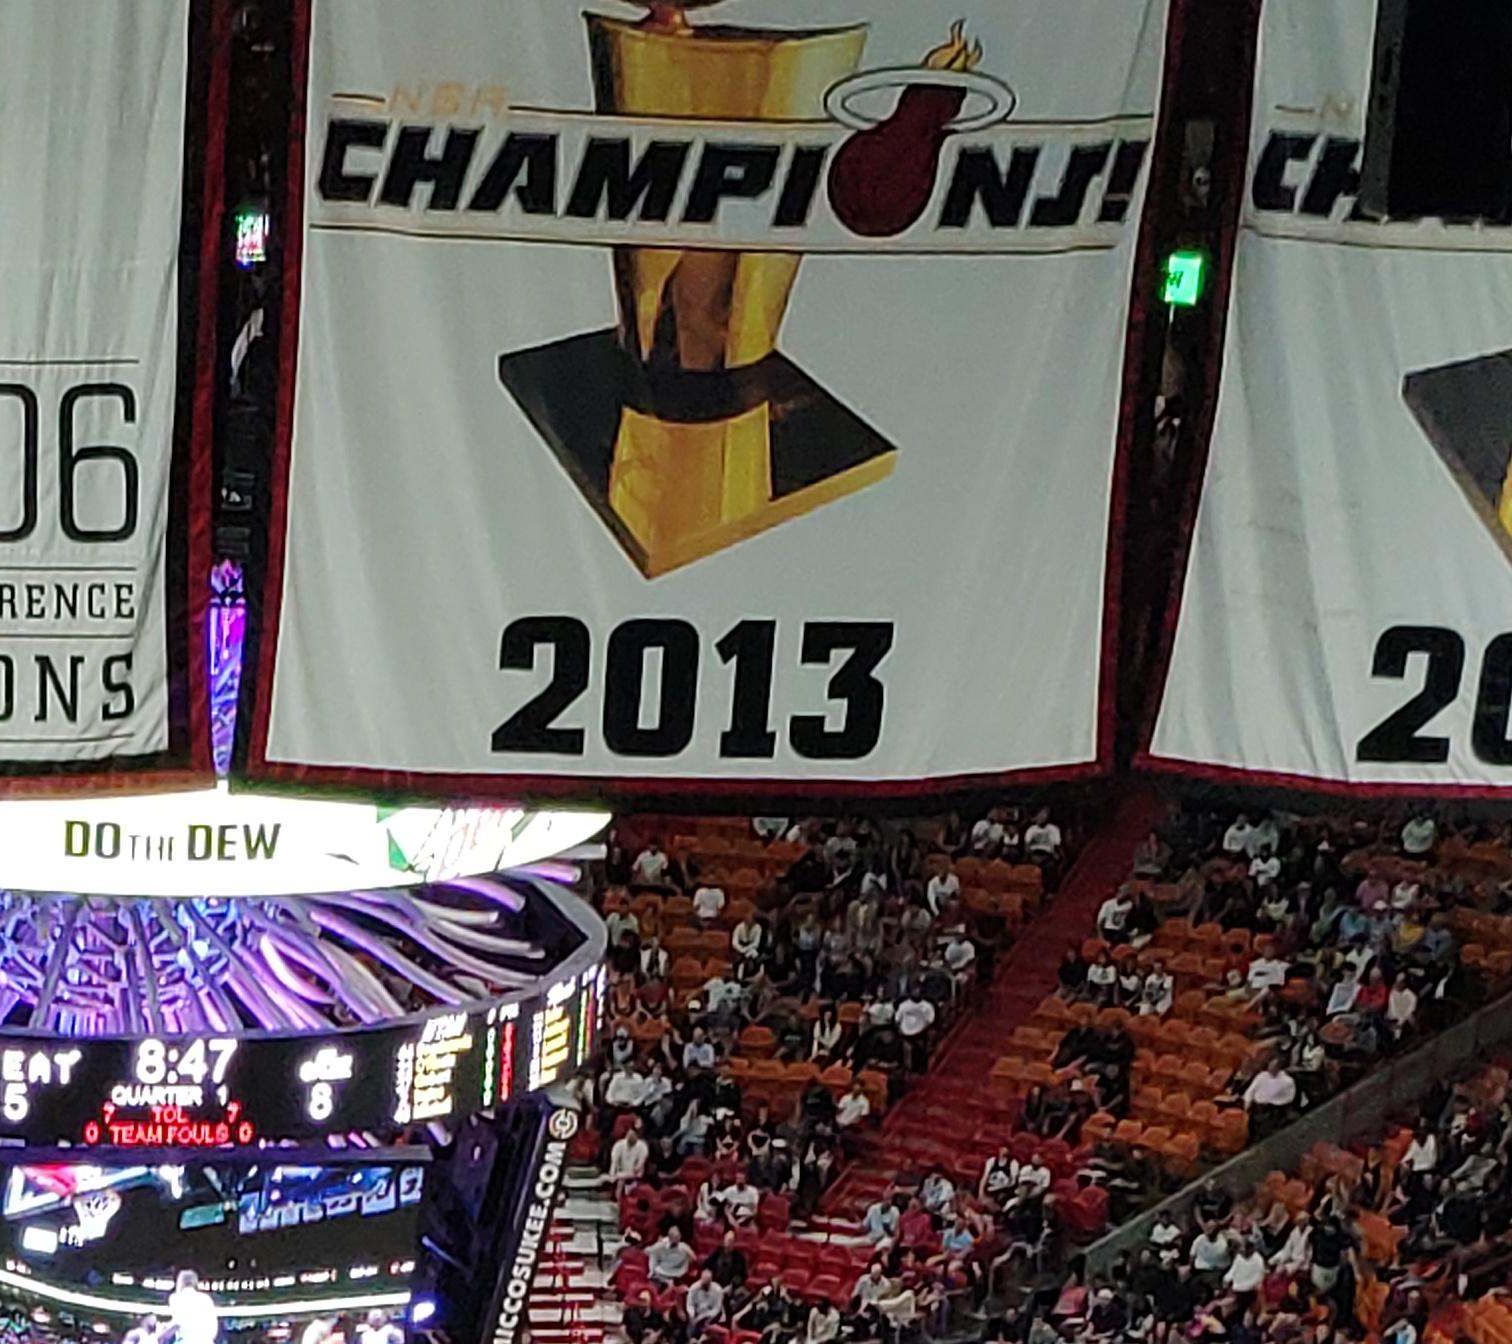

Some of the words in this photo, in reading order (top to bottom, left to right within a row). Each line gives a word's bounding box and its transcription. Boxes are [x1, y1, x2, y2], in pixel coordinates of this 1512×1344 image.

[490, 614, 895, 761] 2013
[64, 820, 121, 859] DO
[187, 822, 281, 861] DEW
[136, 1038, 238, 1085] 8:47
[2, 1083, 29, 1121] 5
[111, 1086, 204, 1107] QUARTER
[217, 1086, 229, 1107] 1
[308, 1083, 334, 1121] 8
[109, 1124, 163, 1145] TEAM
